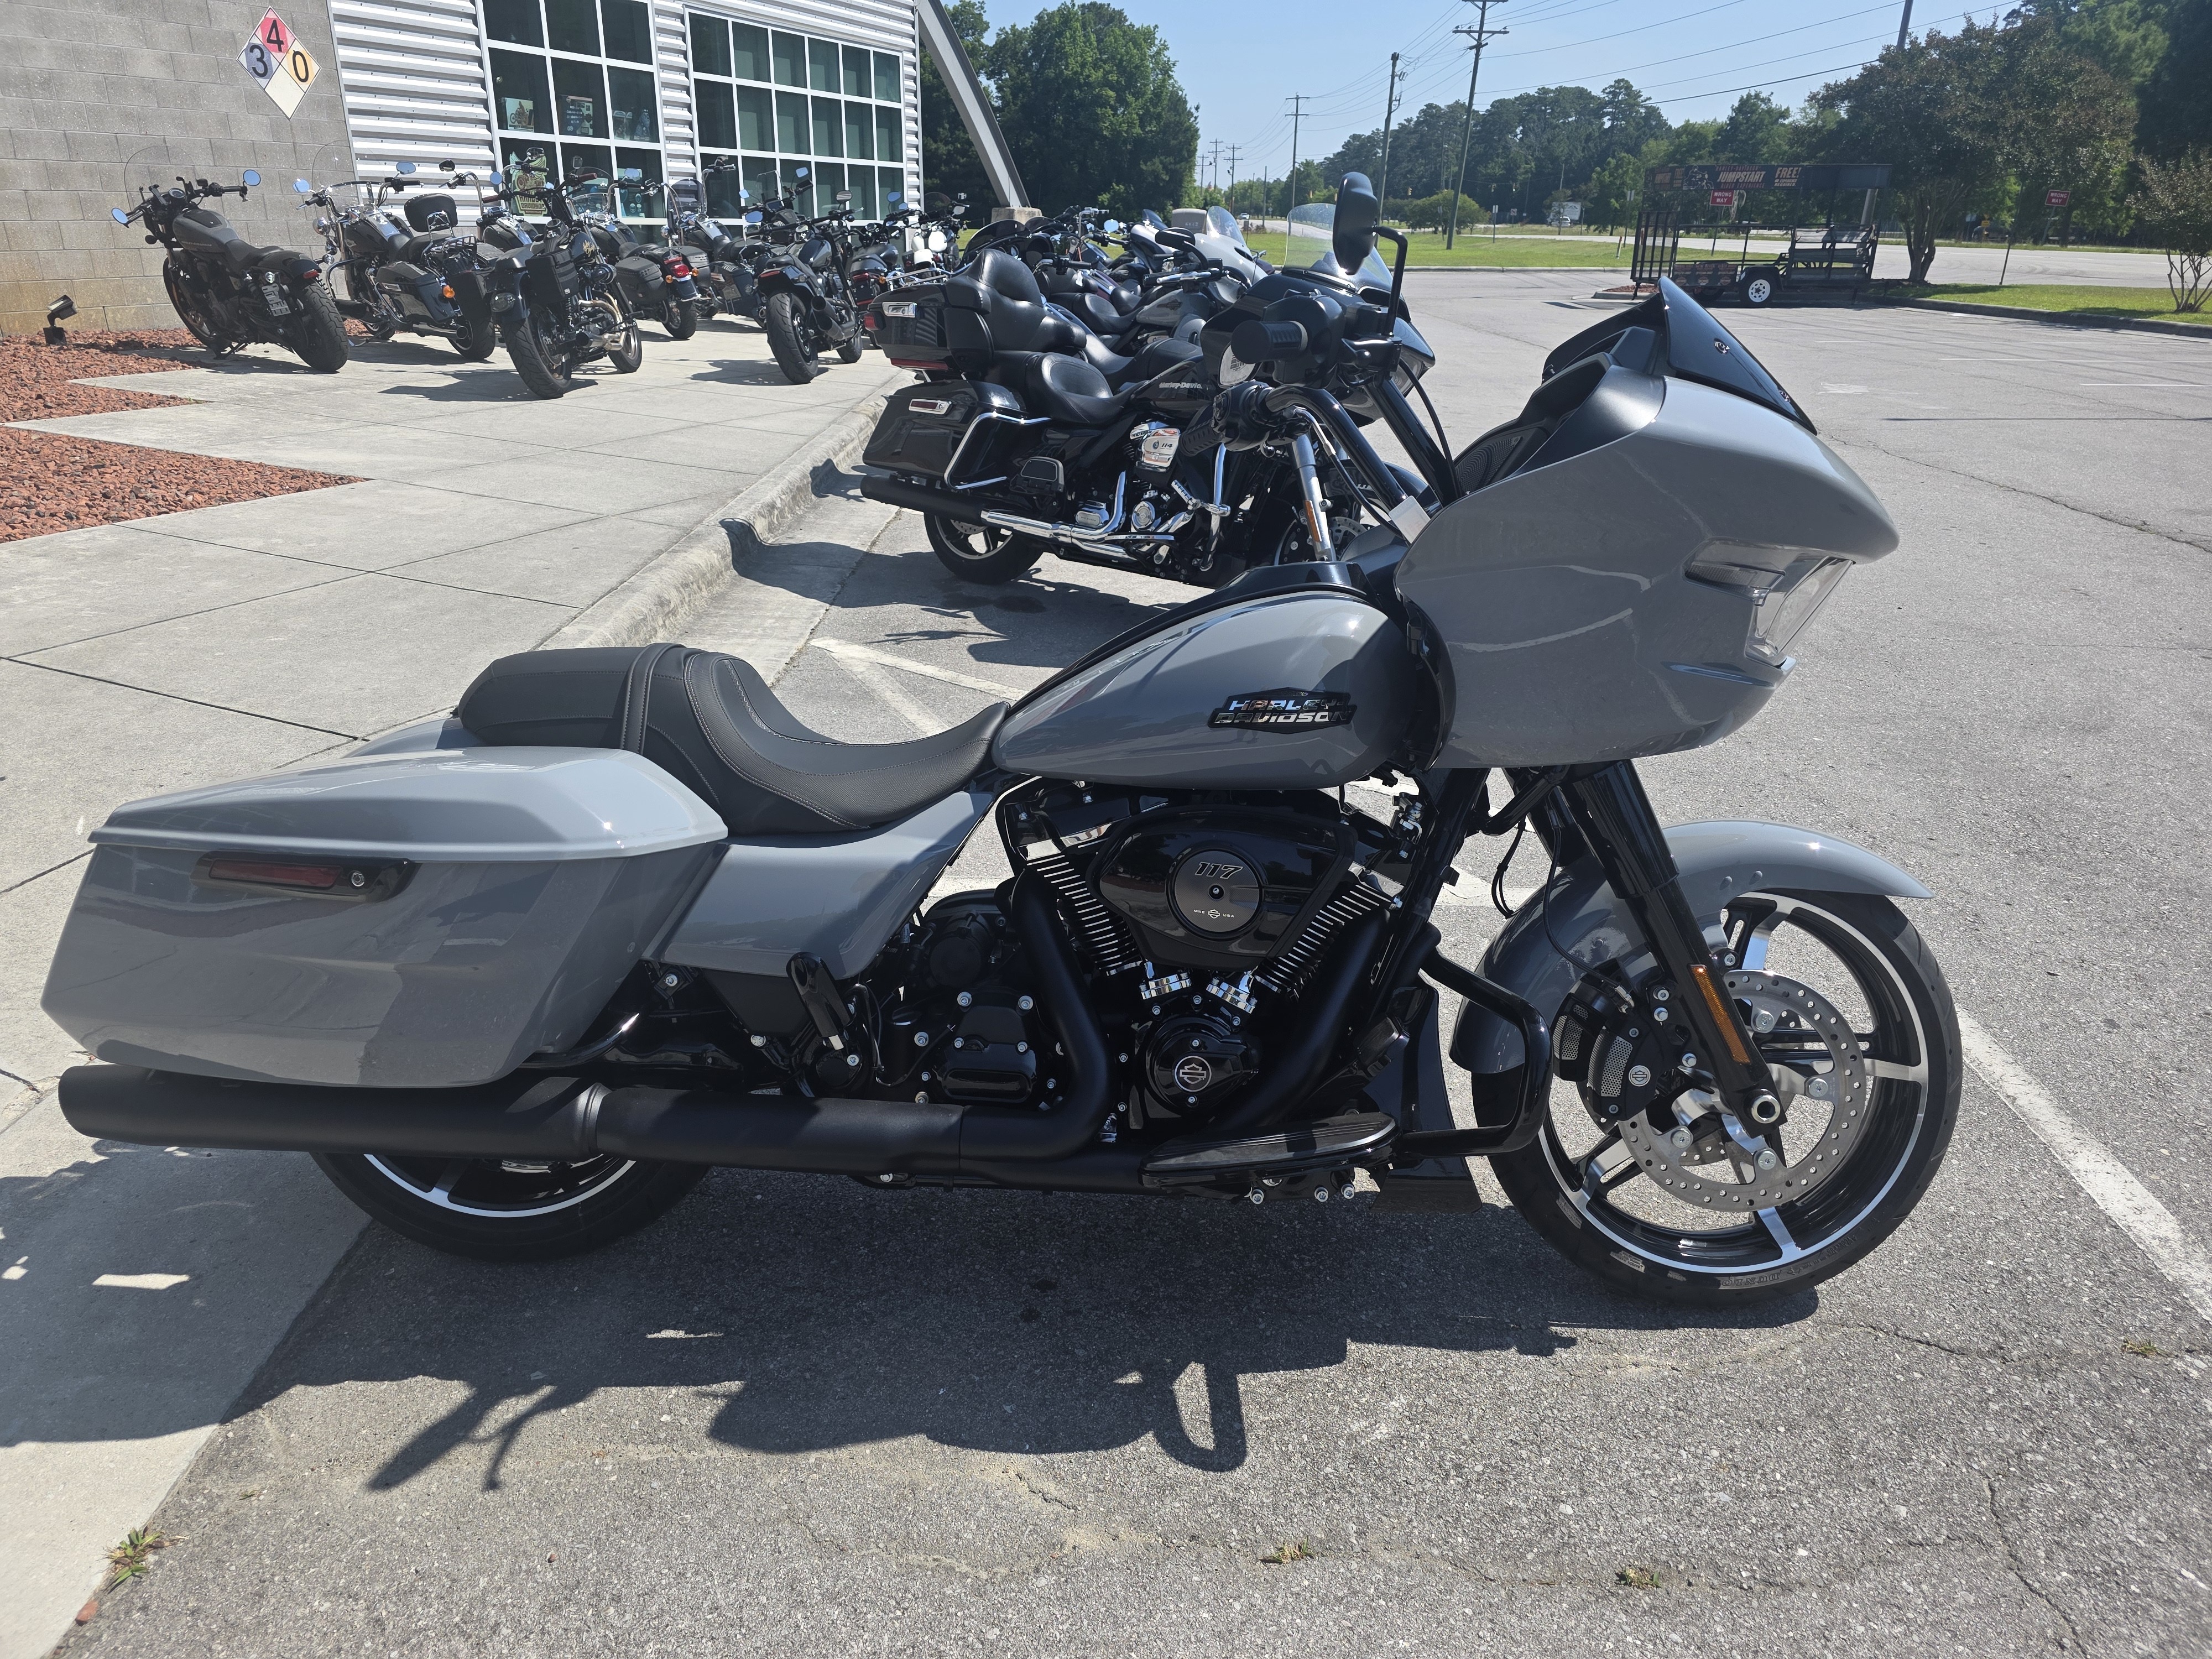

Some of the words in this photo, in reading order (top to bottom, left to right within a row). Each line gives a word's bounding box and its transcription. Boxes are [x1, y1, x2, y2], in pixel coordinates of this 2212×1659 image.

[267, 19, 284, 52] 4
[249, 44, 268, 77] 3
[292, 50, 309, 83] 0
[1717, 171, 1766, 182] JUMPSTART
[1775, 167, 1802, 178] FREE!
[1214, 711, 1353, 724] DAVIDSON
[1194, 862, 1244, 879] 117
[1720, 1274, 1780, 1287] DUNLO
